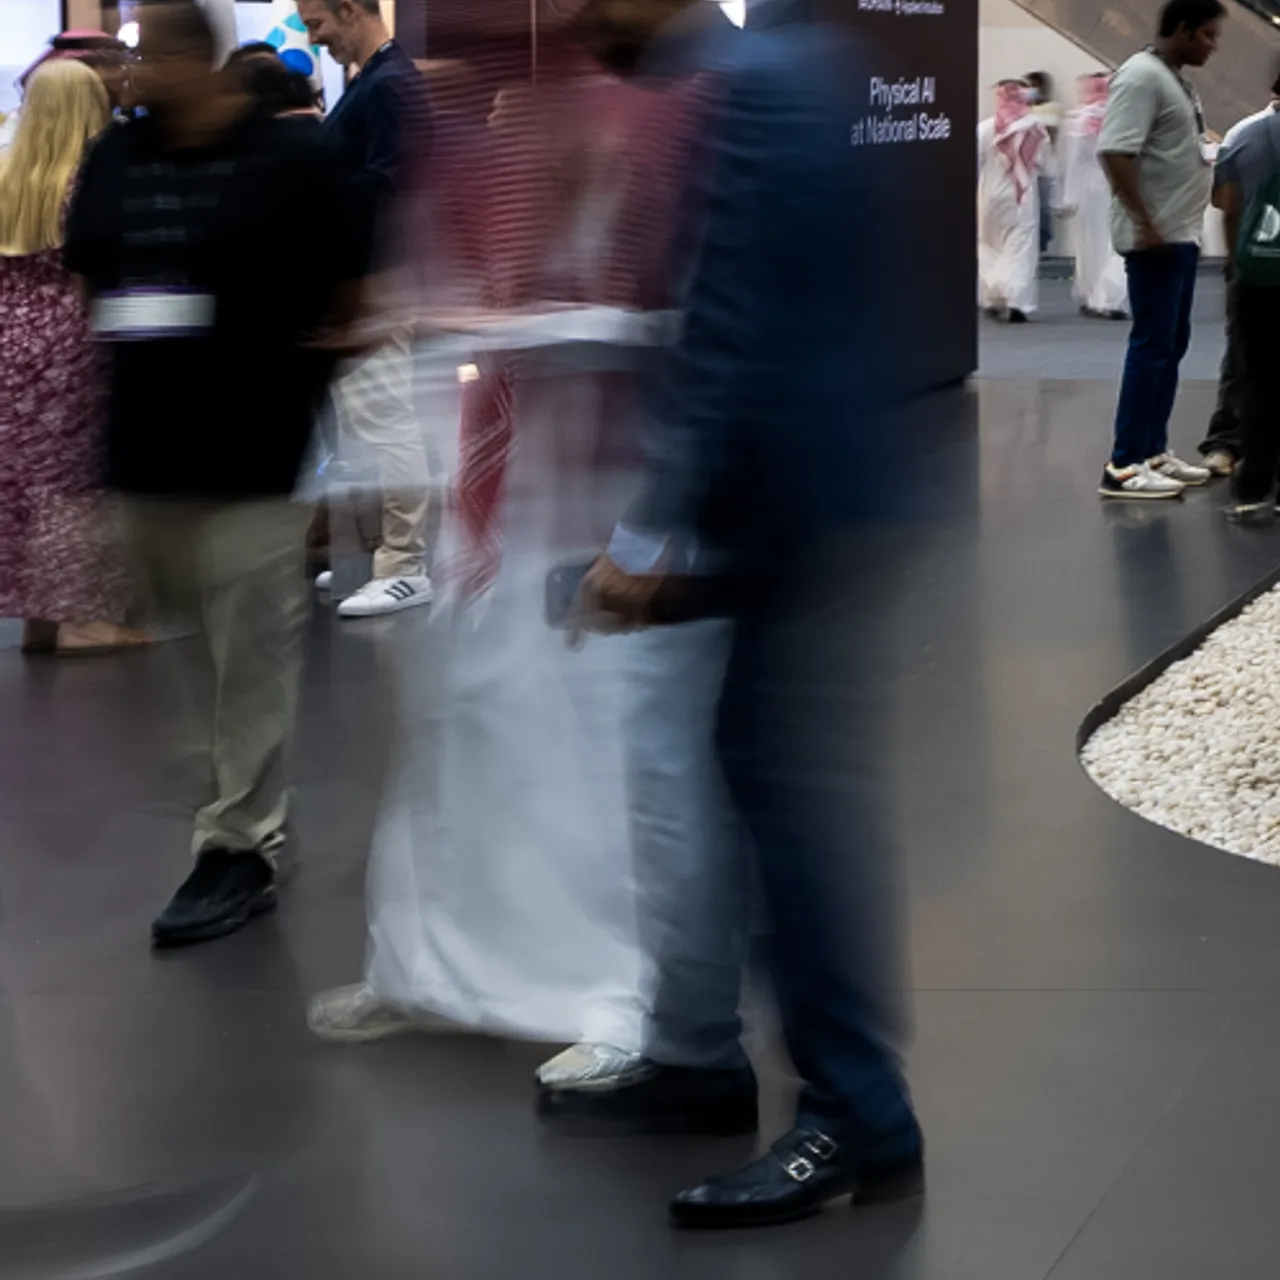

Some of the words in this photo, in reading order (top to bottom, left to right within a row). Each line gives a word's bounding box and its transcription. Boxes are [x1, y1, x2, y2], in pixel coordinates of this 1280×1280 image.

[869, 76, 921, 112] Physical
[922, 76, 936, 104] AI
[850, 119, 864, 146] at
[865, 113, 918, 144] National
[919, 112, 951, 140] Scale
